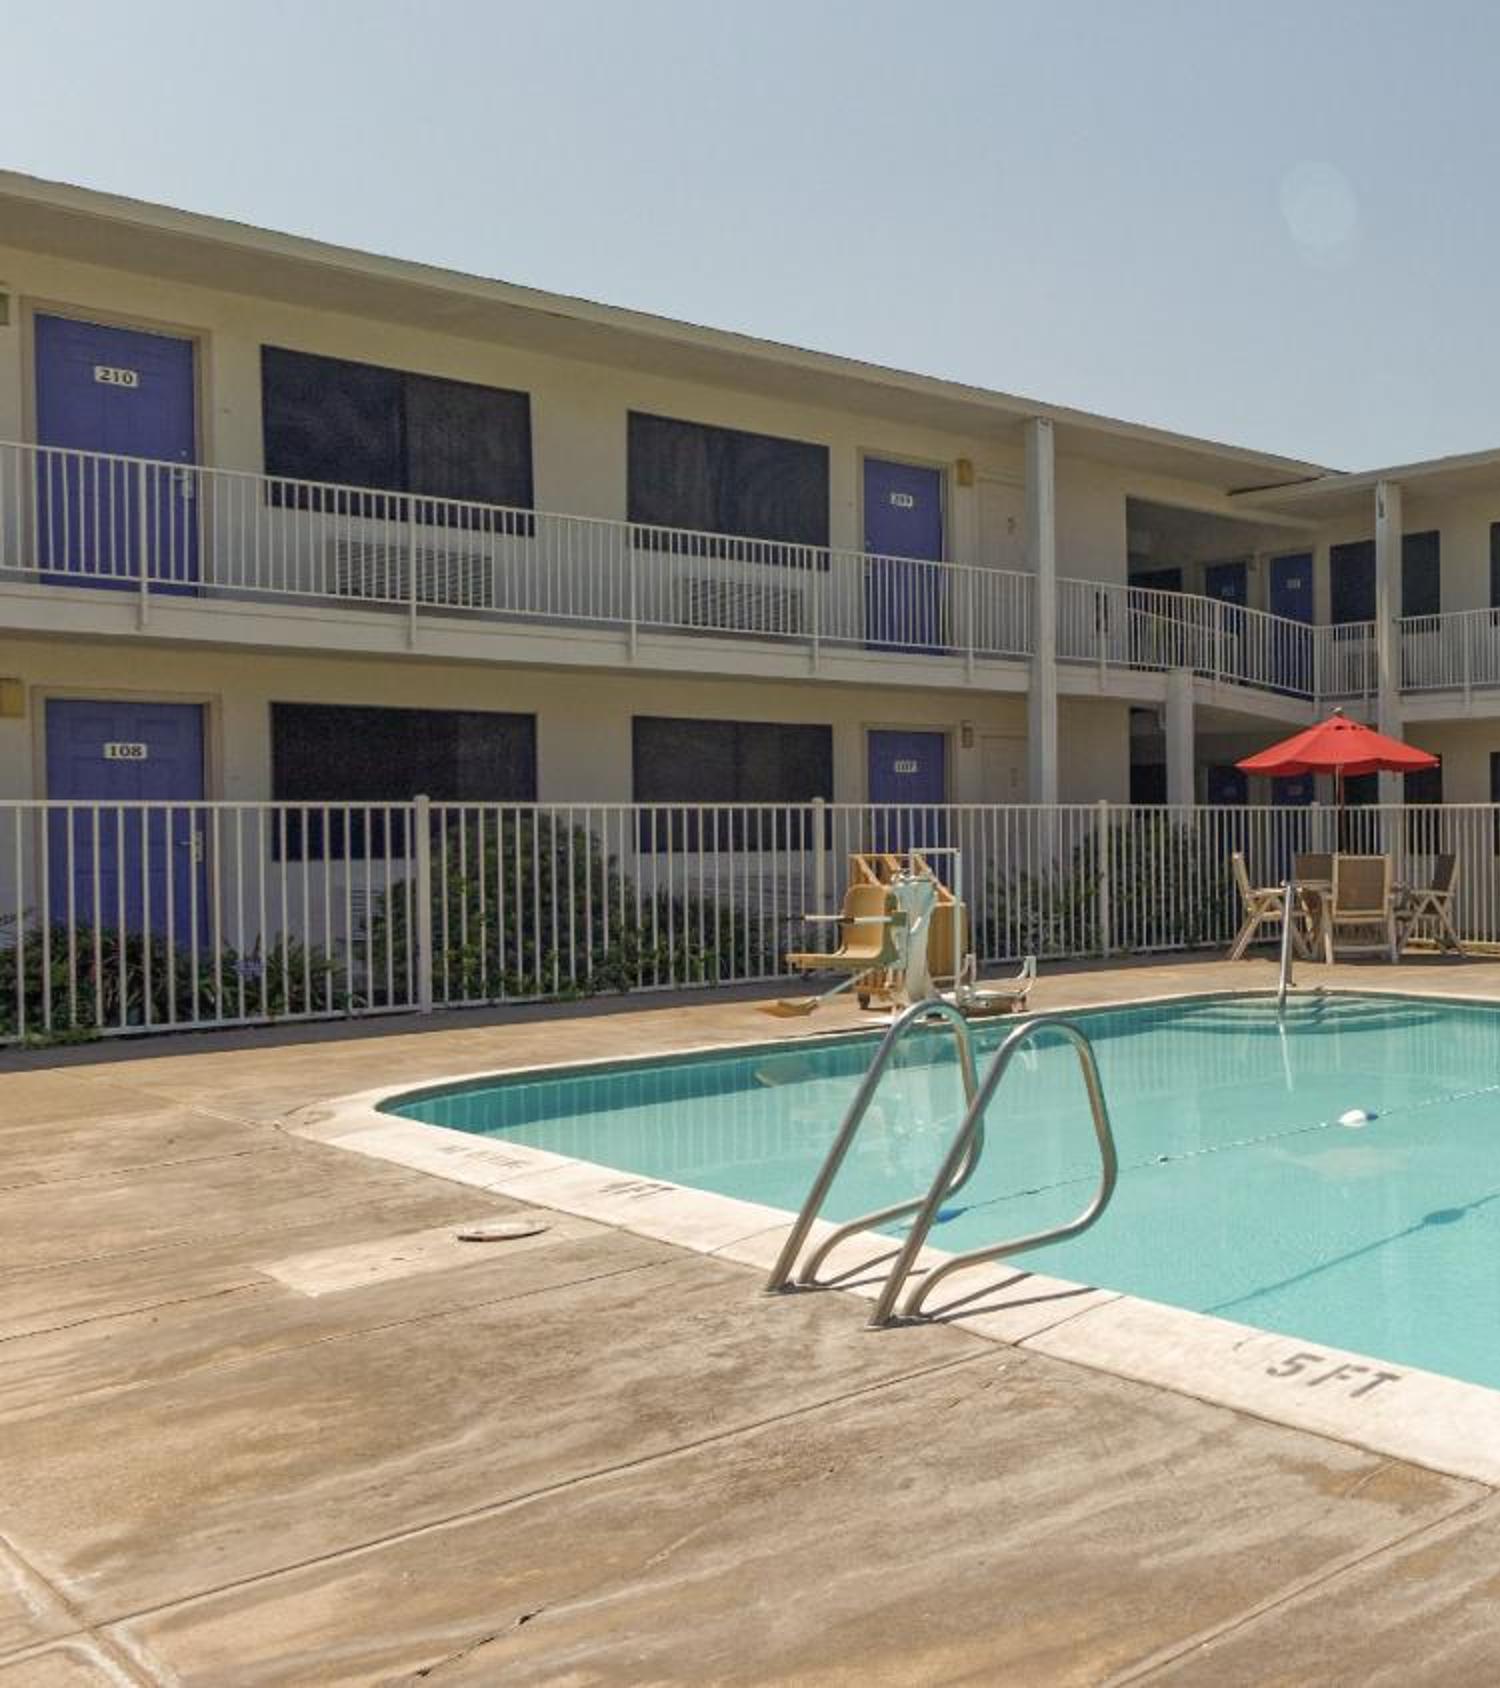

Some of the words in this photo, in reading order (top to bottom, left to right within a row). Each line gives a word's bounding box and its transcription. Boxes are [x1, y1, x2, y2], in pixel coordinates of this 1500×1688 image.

[98, 369, 134, 385] 210
[109, 746, 142, 757] 108
[1266, 1353, 1403, 1397] 5FT
